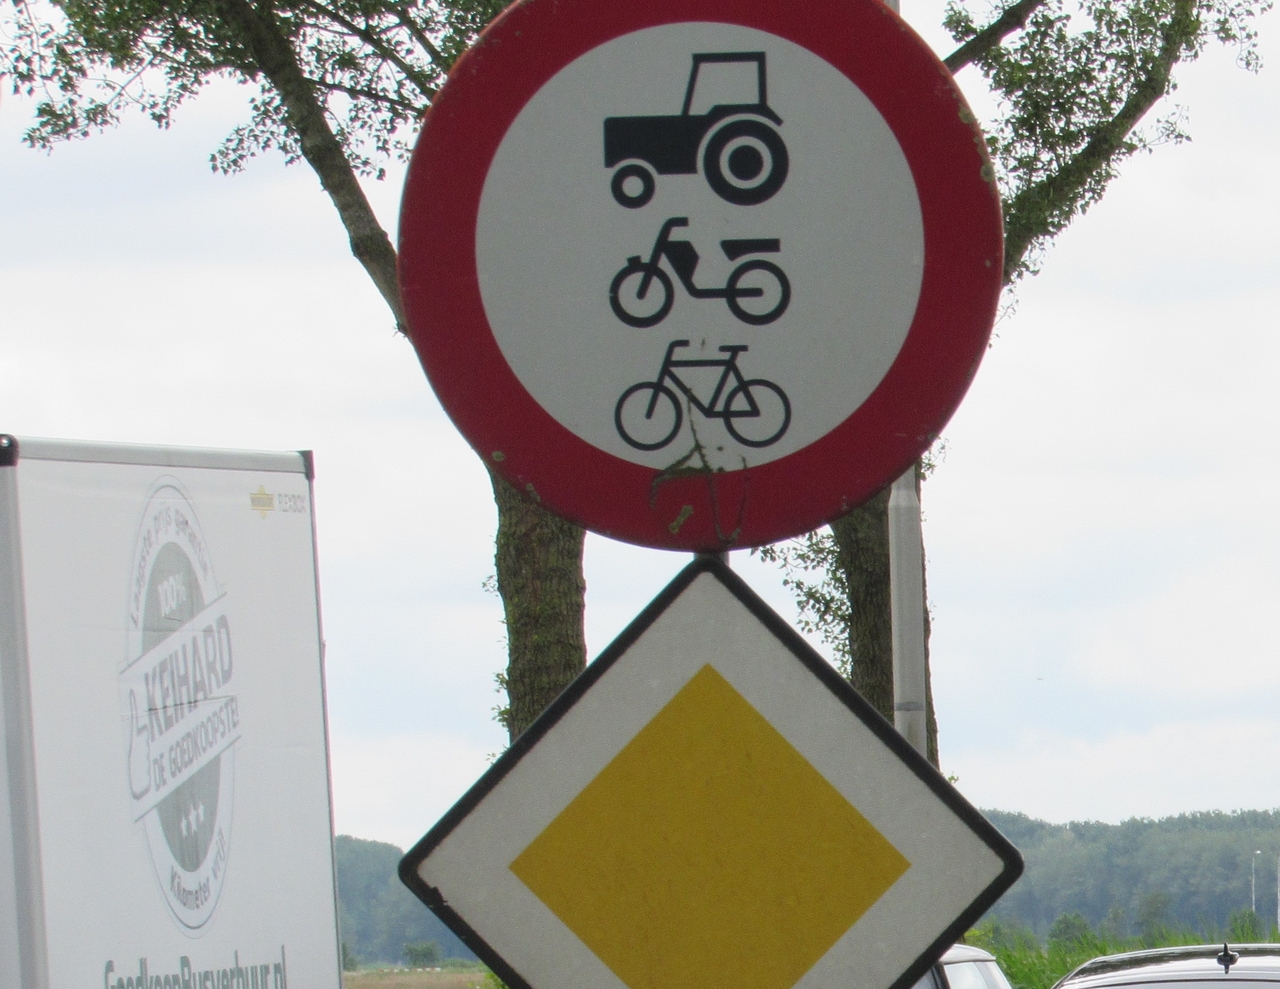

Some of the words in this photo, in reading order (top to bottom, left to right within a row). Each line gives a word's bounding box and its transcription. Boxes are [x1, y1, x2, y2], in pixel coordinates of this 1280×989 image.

[157, 570, 187, 617] 100%
[144, 613, 234, 743] KEIHARD
[152, 752, 167, 793] DE
[168, 695, 240, 778] GOEDKOOPSTE!
[170, 864, 211, 911] Kilometer
